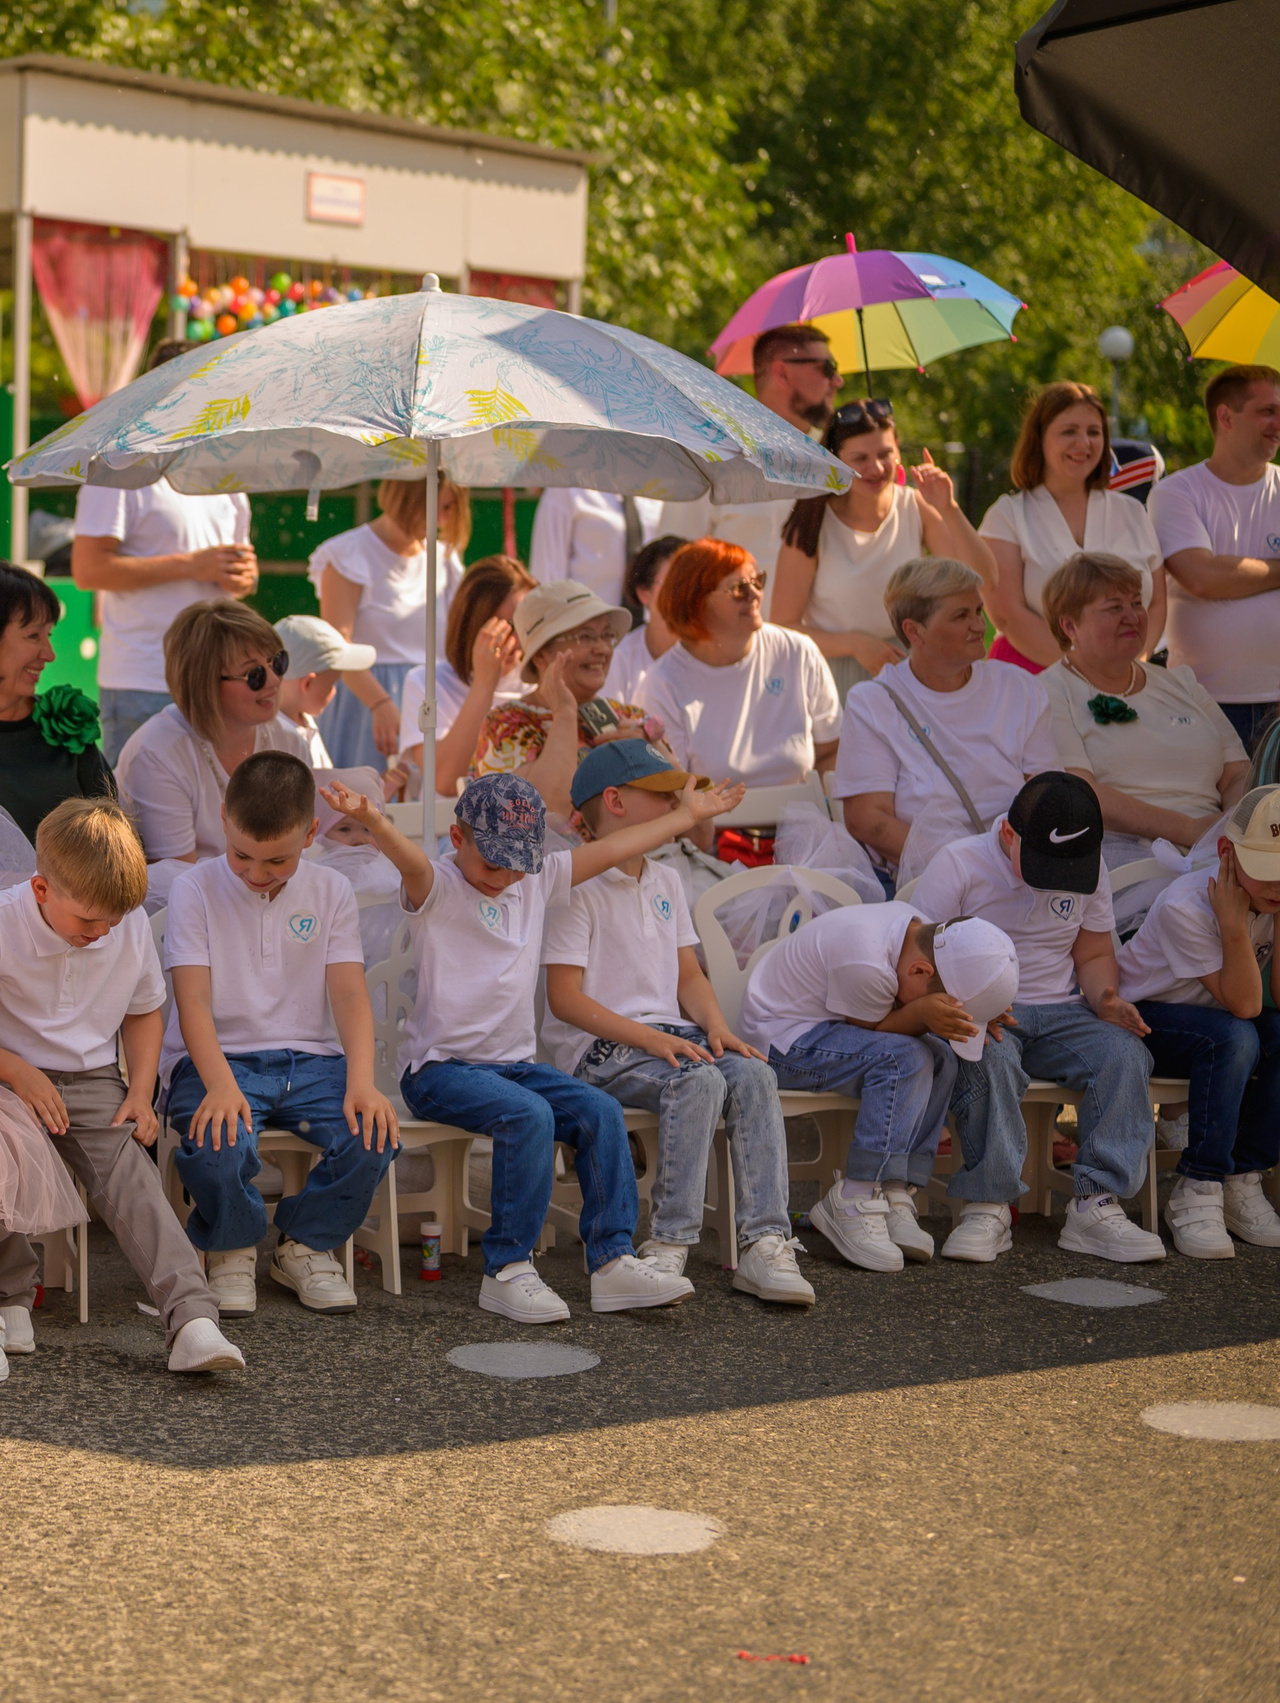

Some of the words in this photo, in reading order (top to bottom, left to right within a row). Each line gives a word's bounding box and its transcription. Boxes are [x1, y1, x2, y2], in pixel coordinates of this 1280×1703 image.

[1270, 823, 1280, 838] B
[661, 900, 670, 913] Я
[1059, 899, 1072, 914] Я
[299, 918, 314, 933] Я
